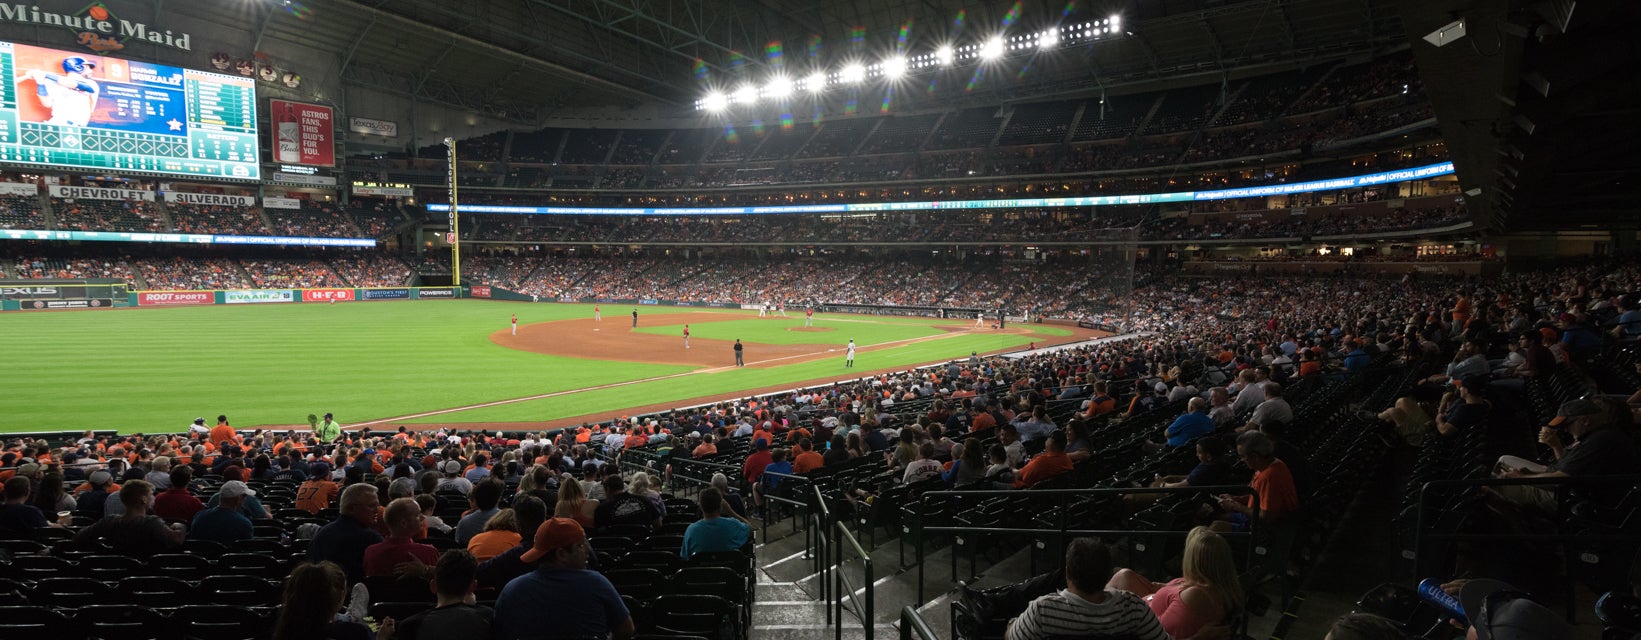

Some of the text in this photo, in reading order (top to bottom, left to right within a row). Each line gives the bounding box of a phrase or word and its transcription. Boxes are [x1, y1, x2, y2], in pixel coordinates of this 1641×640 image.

[0, 2, 191, 50] Minute Maid
[302, 110, 329, 120] ASTROS
[302, 118, 322, 127] FANS,
[303, 133, 324, 141] BUD'S
[303, 147, 320, 155] YOU.
[1390, 171, 1414, 180] OFFICIAL
[1415, 168, 1438, 176] UNIFORM
[1326, 179, 1355, 188] BASEBALL
[60, 187, 146, 200] CHEVROLET
[176, 194, 246, 206] SILVERADO
[916, 464, 941, 476] CORRE
[299, 486, 318, 499] 27
[1428, 586, 1459, 610] ULTRA
